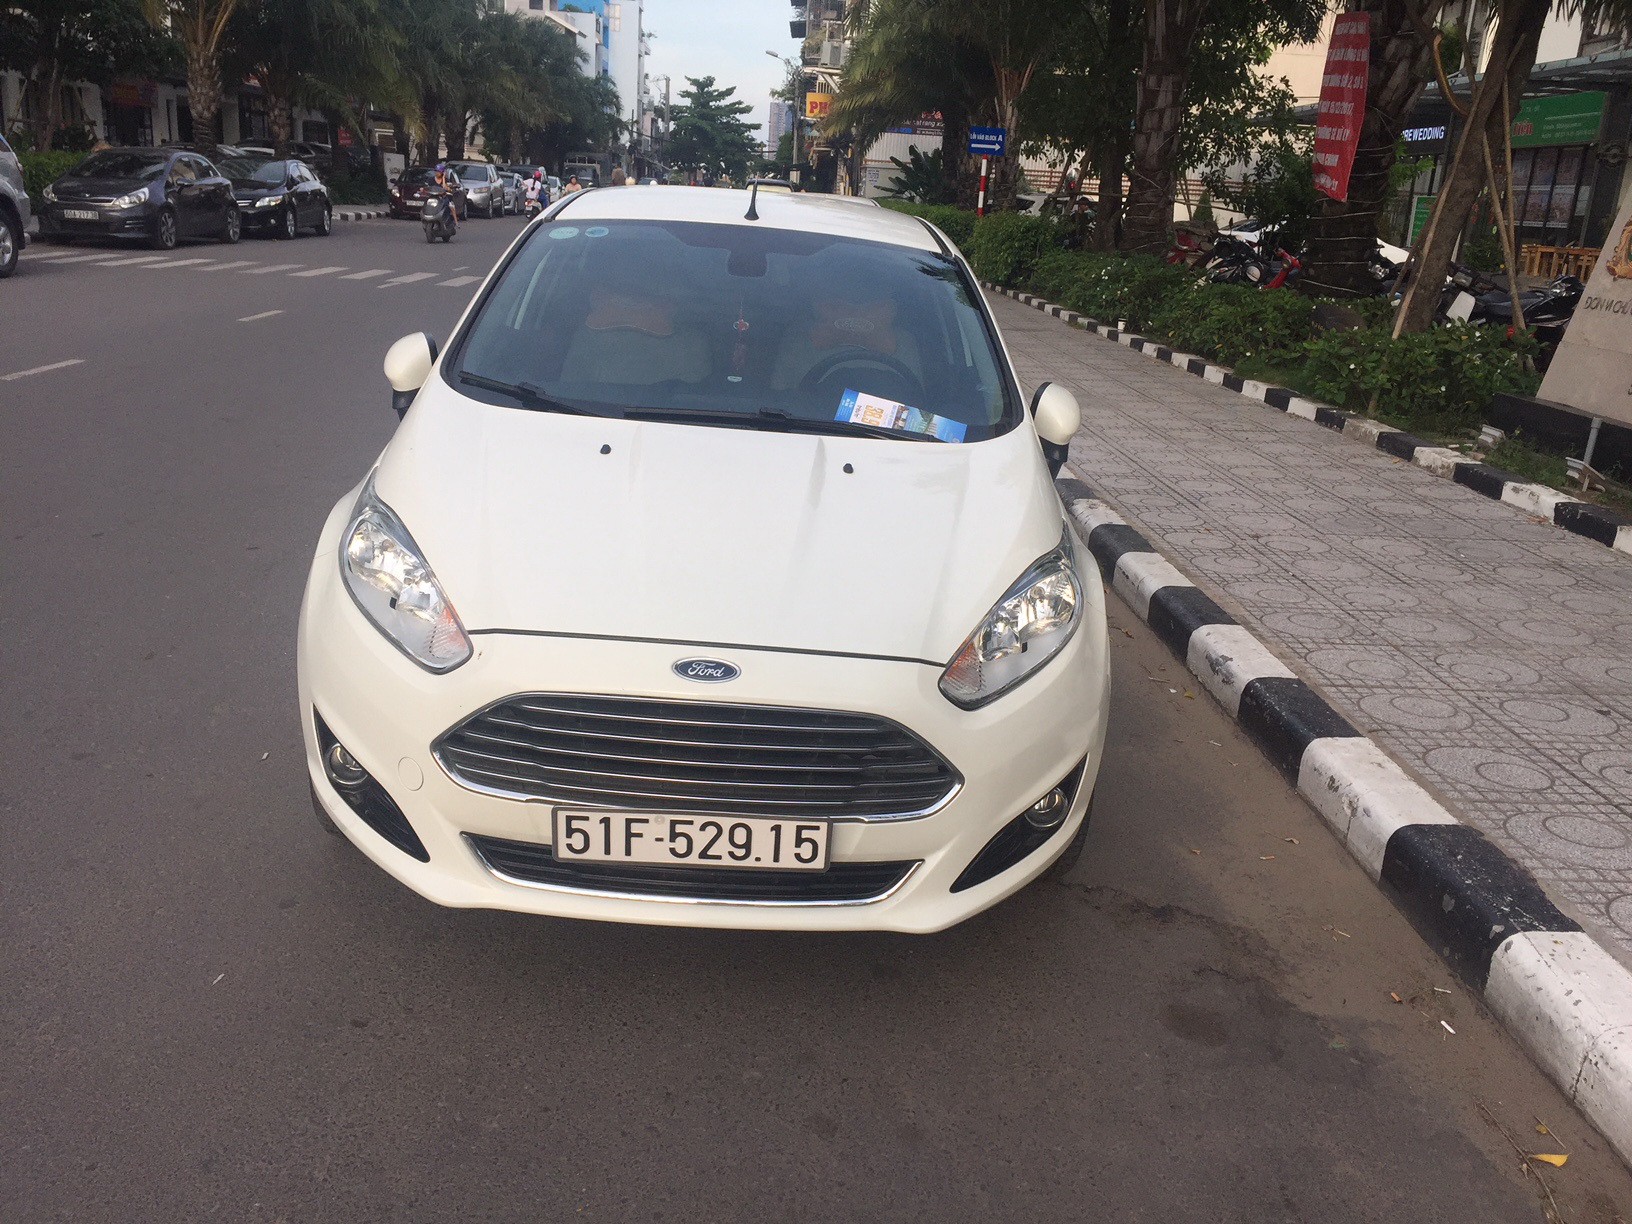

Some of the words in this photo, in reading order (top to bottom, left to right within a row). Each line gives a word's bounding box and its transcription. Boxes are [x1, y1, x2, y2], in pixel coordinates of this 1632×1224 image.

[809, 101, 830, 114] PH
[687, 661, 726, 677] Ford
[565, 814, 821, 864] 51F-529.15
